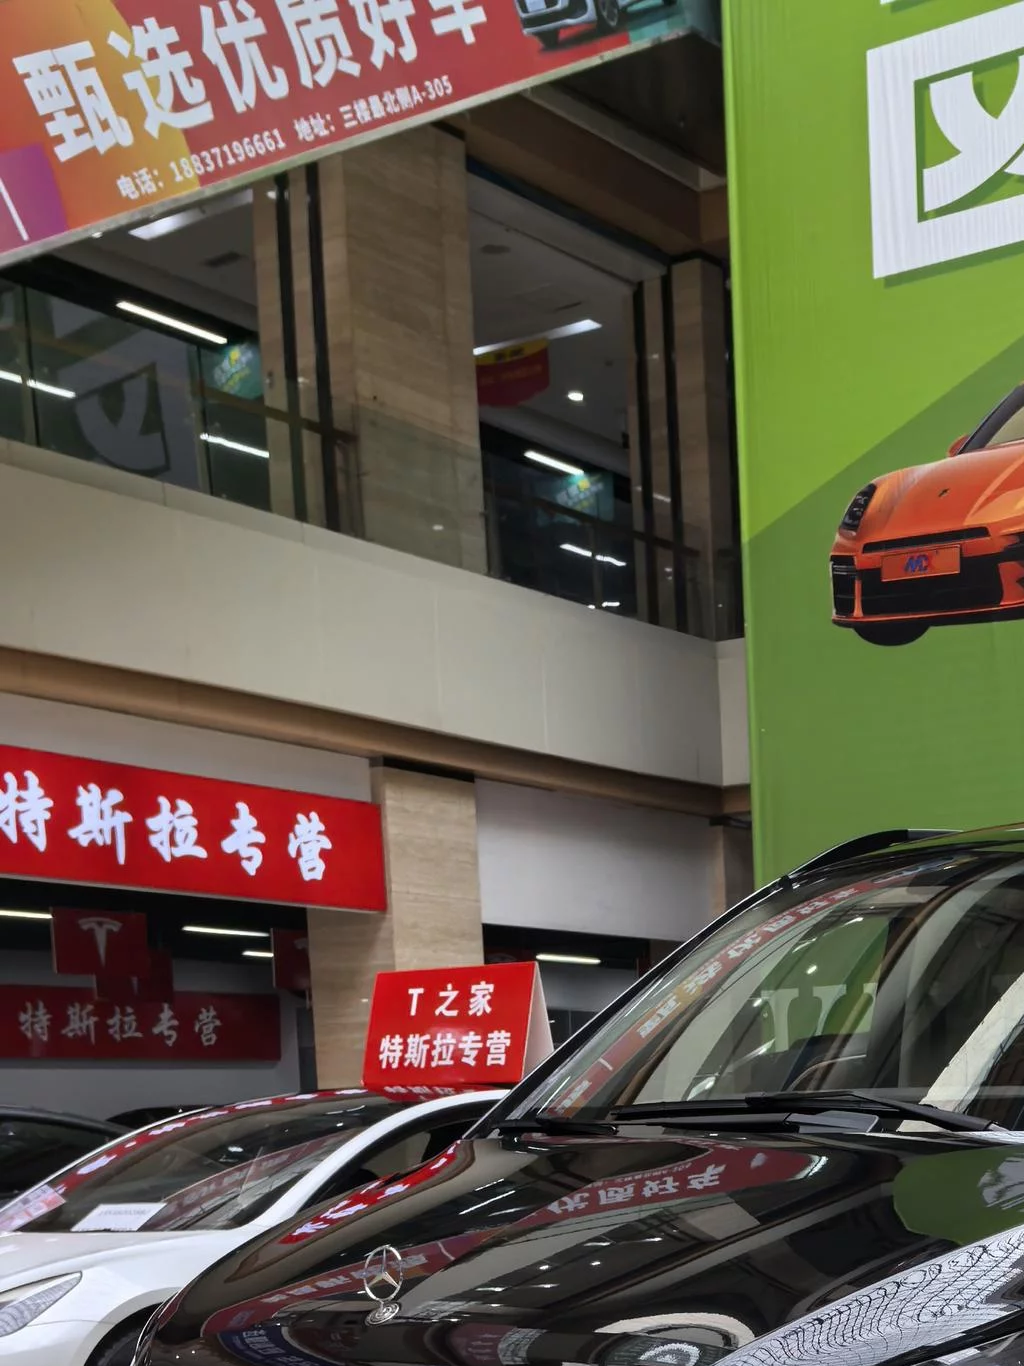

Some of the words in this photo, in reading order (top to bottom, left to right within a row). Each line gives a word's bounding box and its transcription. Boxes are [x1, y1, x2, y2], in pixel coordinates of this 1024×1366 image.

[0, 770, 333, 881] 特斯拉专营
[408, 981, 495, 1017] T之家
[18, 1001, 223, 1047] 特斯拉专营
[379, 1030, 512, 1069] 特斯拉专营
